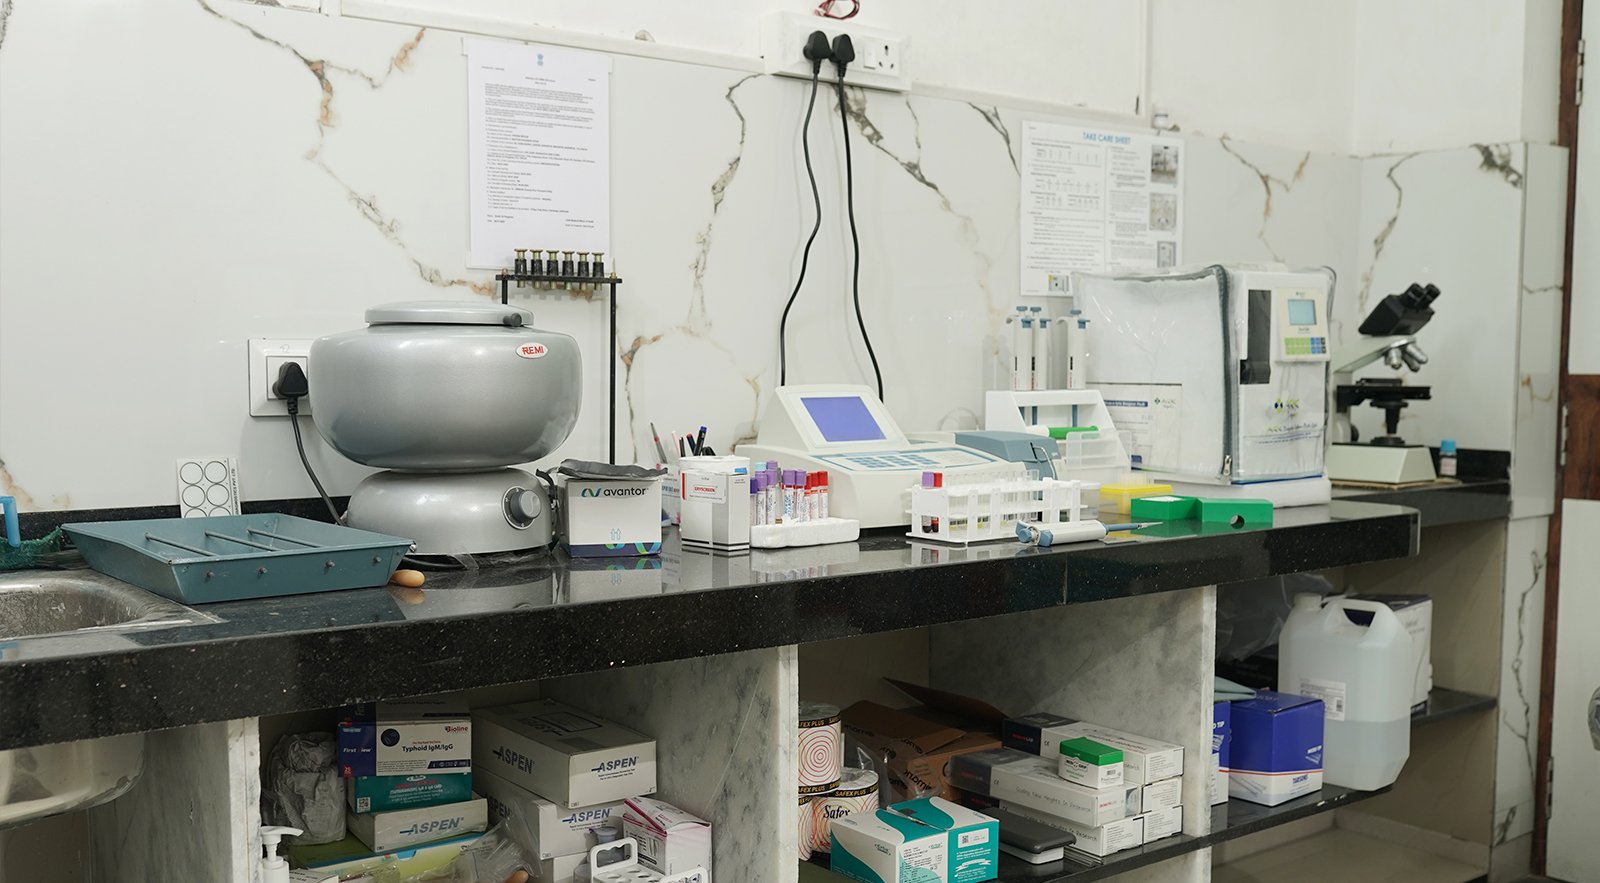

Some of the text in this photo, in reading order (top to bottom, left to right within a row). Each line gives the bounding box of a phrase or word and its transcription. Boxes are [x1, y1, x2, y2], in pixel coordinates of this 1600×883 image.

[1082, 132, 1132, 145] TAKE CARE SHEET
[521, 346, 544, 355] REMI
[603, 487, 646, 497] avantor
[402, 743, 453, 753] Typhoid IgM/IgG
[493, 745, 533, 775] ASPEN
[592, 756, 636, 773] ASPEN
[562, 808, 610, 824] ASPEN
[400, 817, 460, 836] ASPEN
